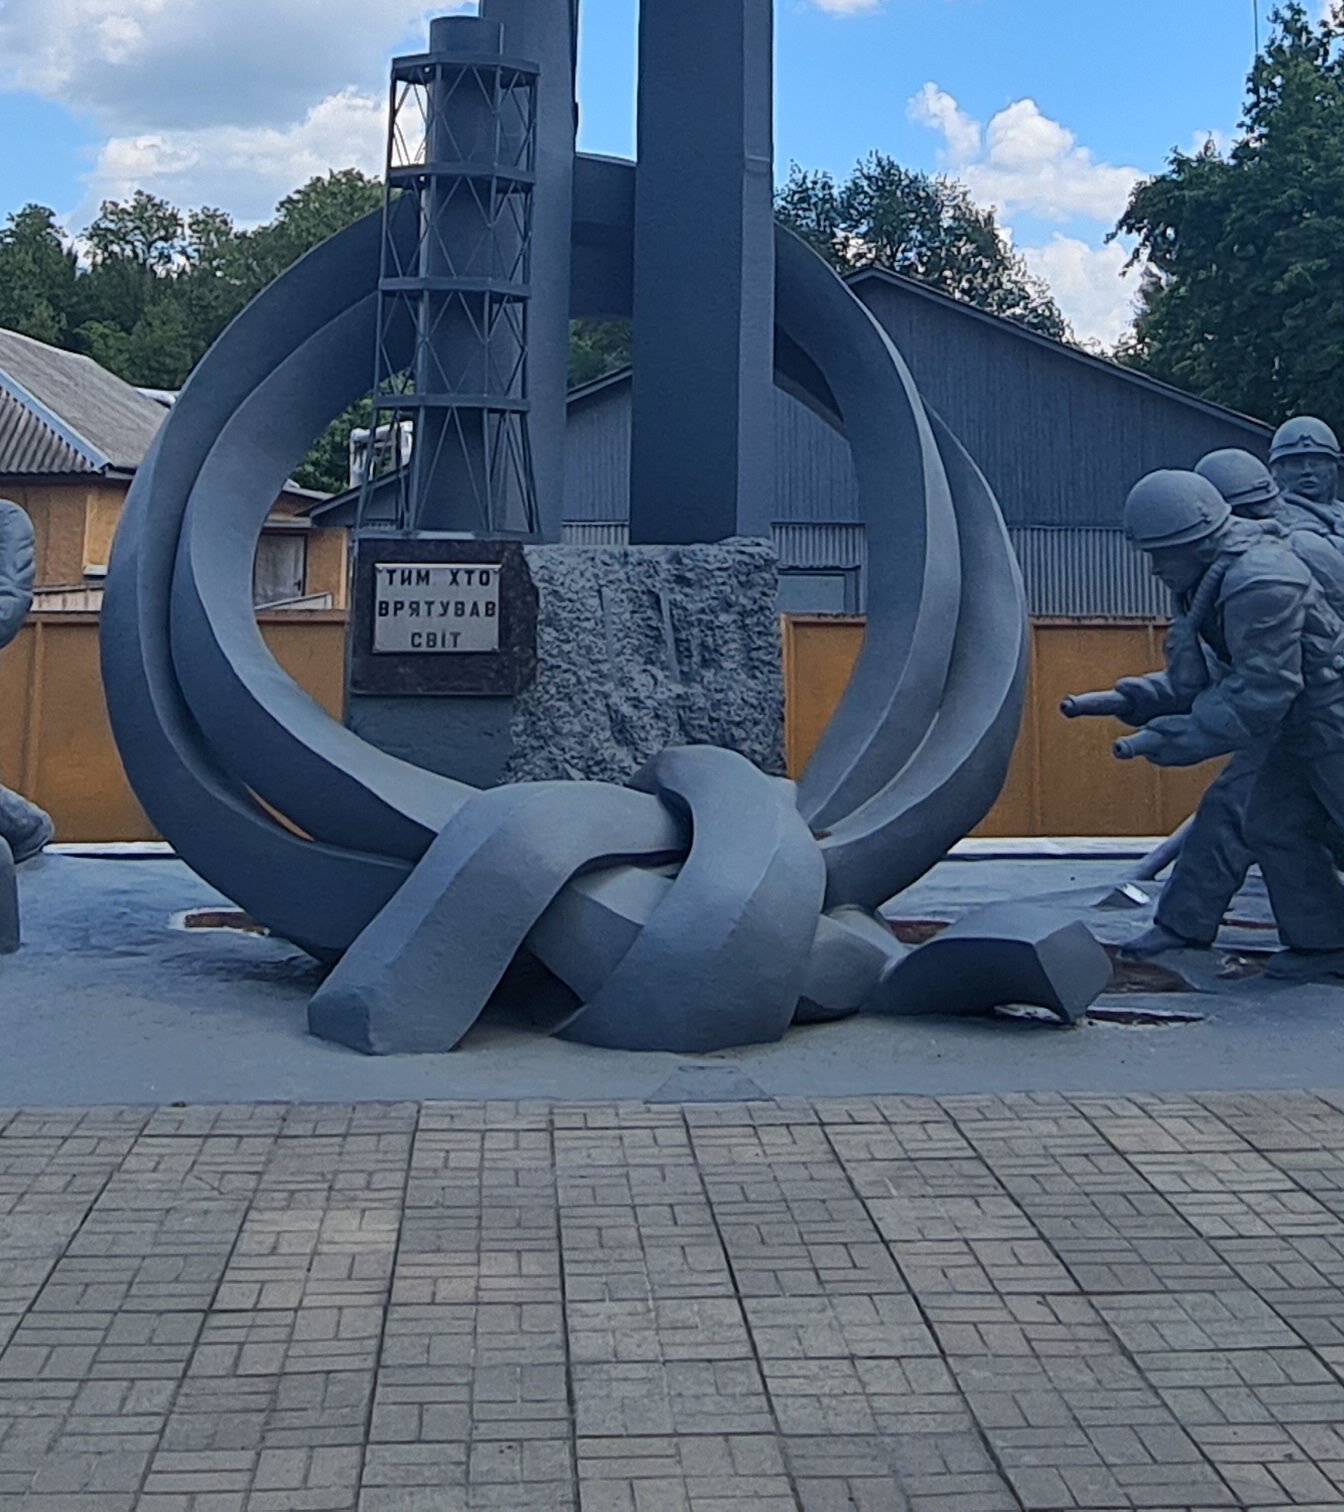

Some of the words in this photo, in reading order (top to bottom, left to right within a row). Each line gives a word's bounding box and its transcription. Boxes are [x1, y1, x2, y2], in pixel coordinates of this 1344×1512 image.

[386, 570, 430, 586] ТИМ
[449, 569, 491, 586] ХТО
[378, 600, 497, 617] ВРЯТУВАВ
[411, 629, 462, 648] СВІТ
